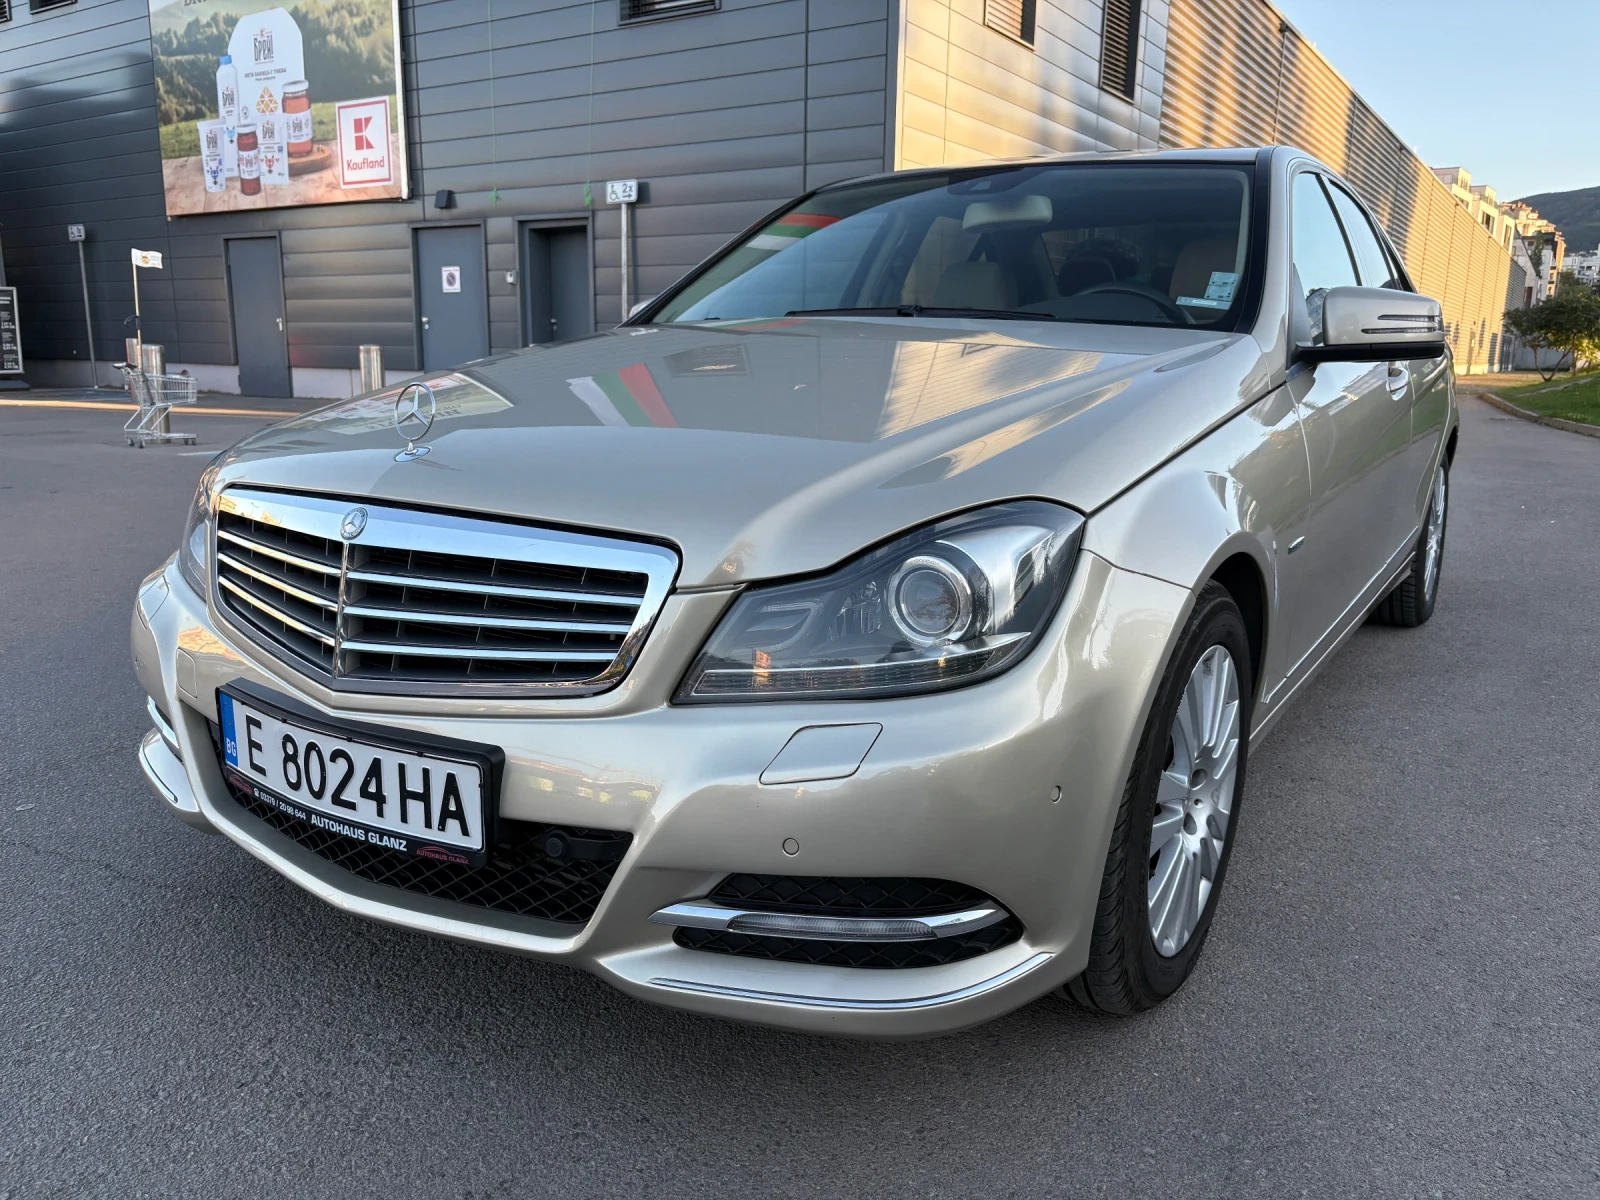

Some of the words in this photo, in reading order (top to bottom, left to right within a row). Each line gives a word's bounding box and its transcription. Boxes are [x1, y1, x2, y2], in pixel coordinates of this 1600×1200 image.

[346, 156, 385, 171] Kaufland
[622, 183, 634, 193] 2x
[226, 737, 237, 758] BG
[245, 713, 267, 777] E
[310, 814, 366, 842] AUTOHAUS
[368, 831, 408, 852] GLANZ
[416, 849, 448, 861] AUTOHAUS
[449, 855, 470, 866] GLANZ
